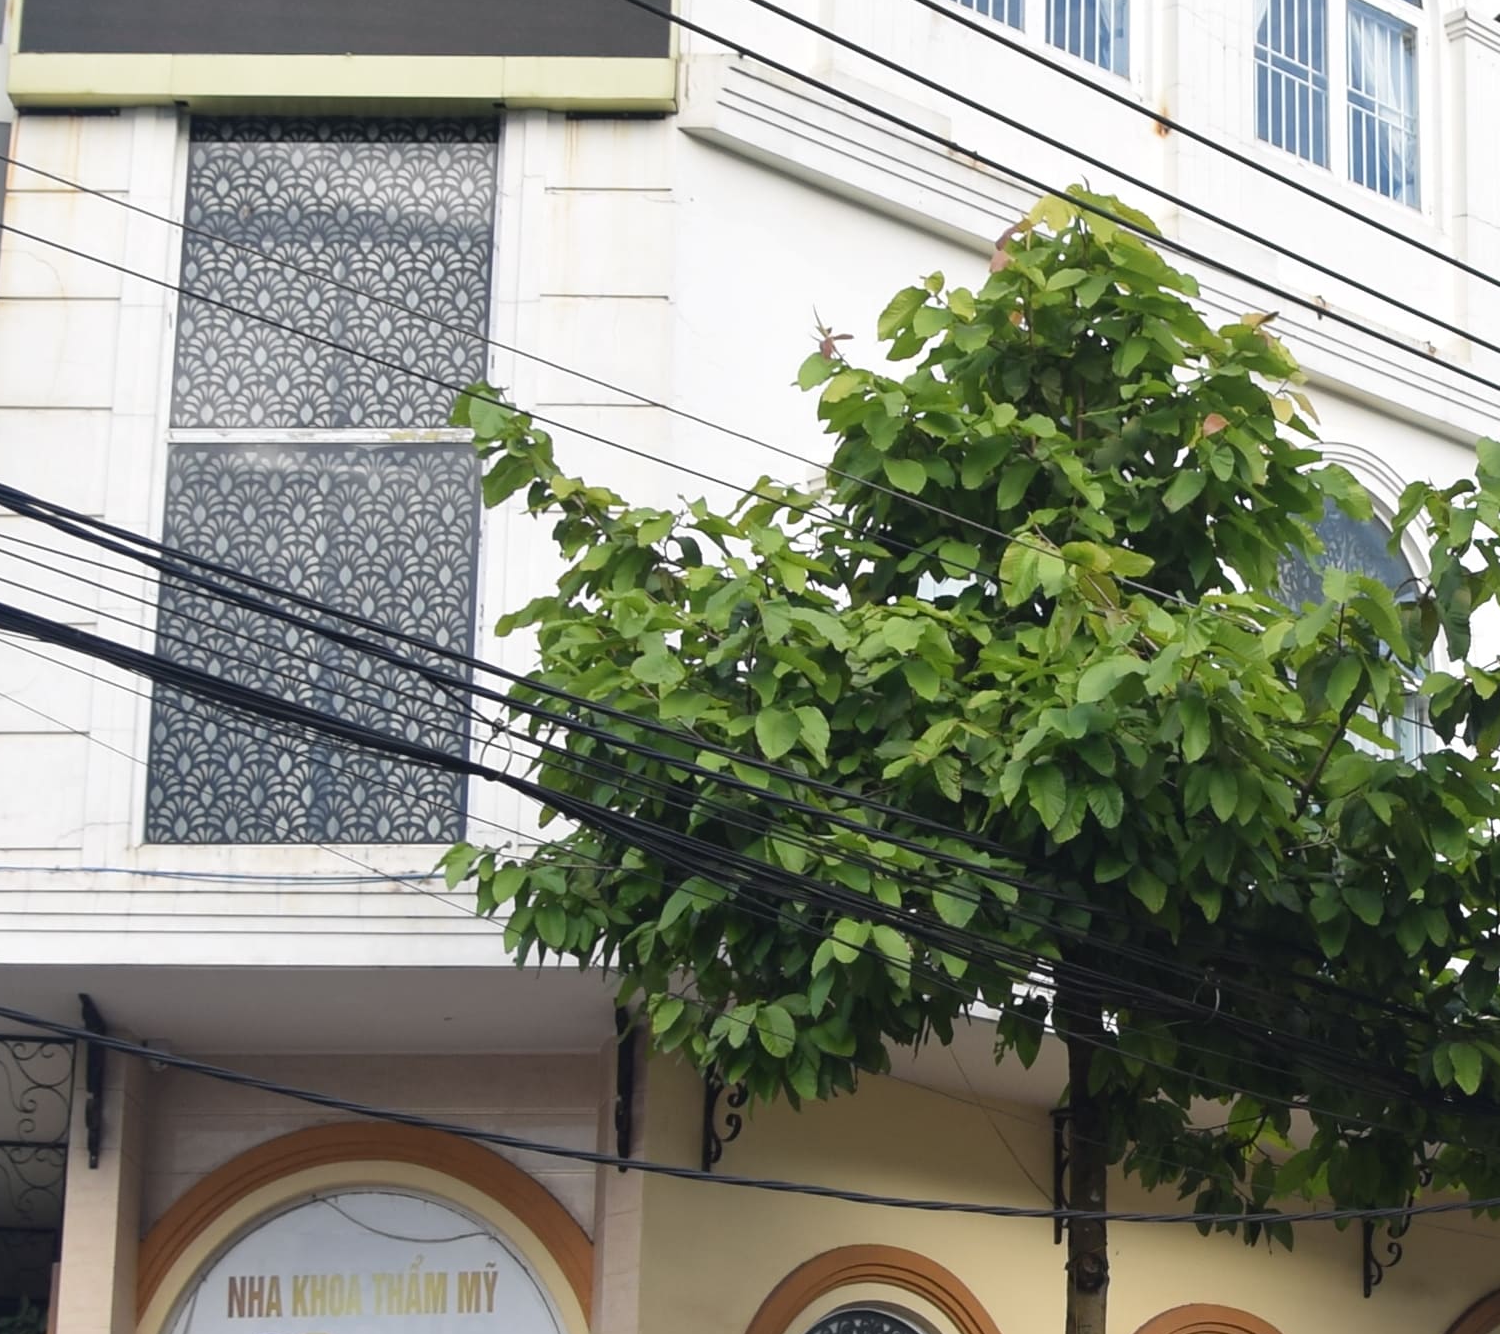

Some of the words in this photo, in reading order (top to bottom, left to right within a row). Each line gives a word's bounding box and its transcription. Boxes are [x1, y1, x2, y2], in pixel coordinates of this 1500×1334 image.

[228, 1275, 282, 1318] NHA
[291, 1274, 363, 1317] KHOA
[457, 1262, 499, 1314] MỸ
